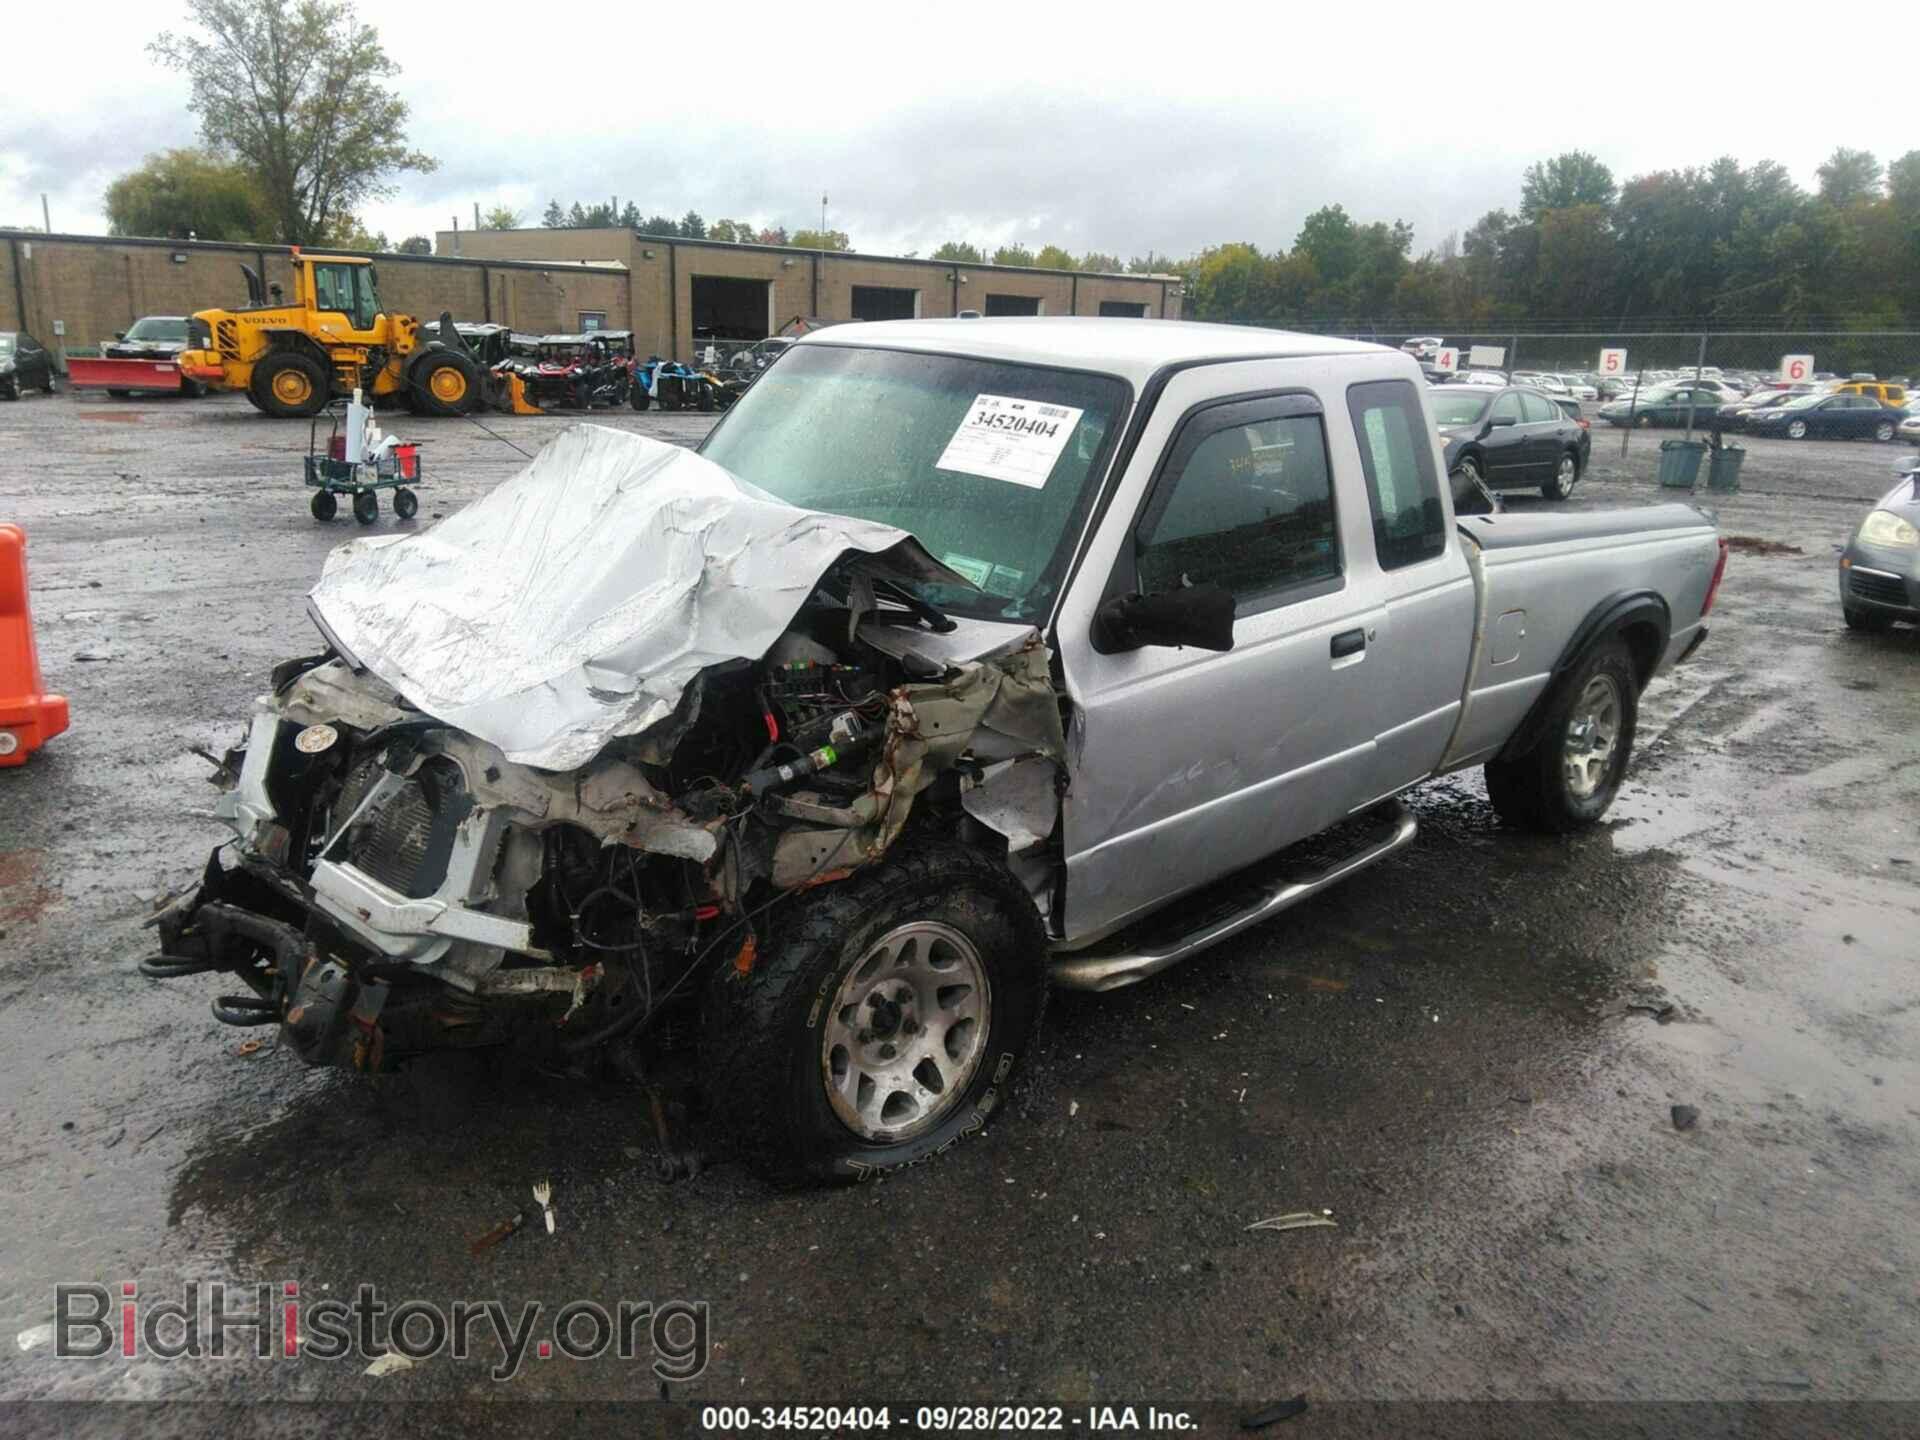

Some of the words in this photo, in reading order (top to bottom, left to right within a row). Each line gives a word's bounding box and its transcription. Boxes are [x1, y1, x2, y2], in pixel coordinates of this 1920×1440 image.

[243, 316, 287, 324] VOLVO
[1440, 351, 1451, 368] 4
[1607, 354, 1618, 371] 5
[1791, 360, 1804, 379] 6
[972, 411, 1059, 438] 34520404
